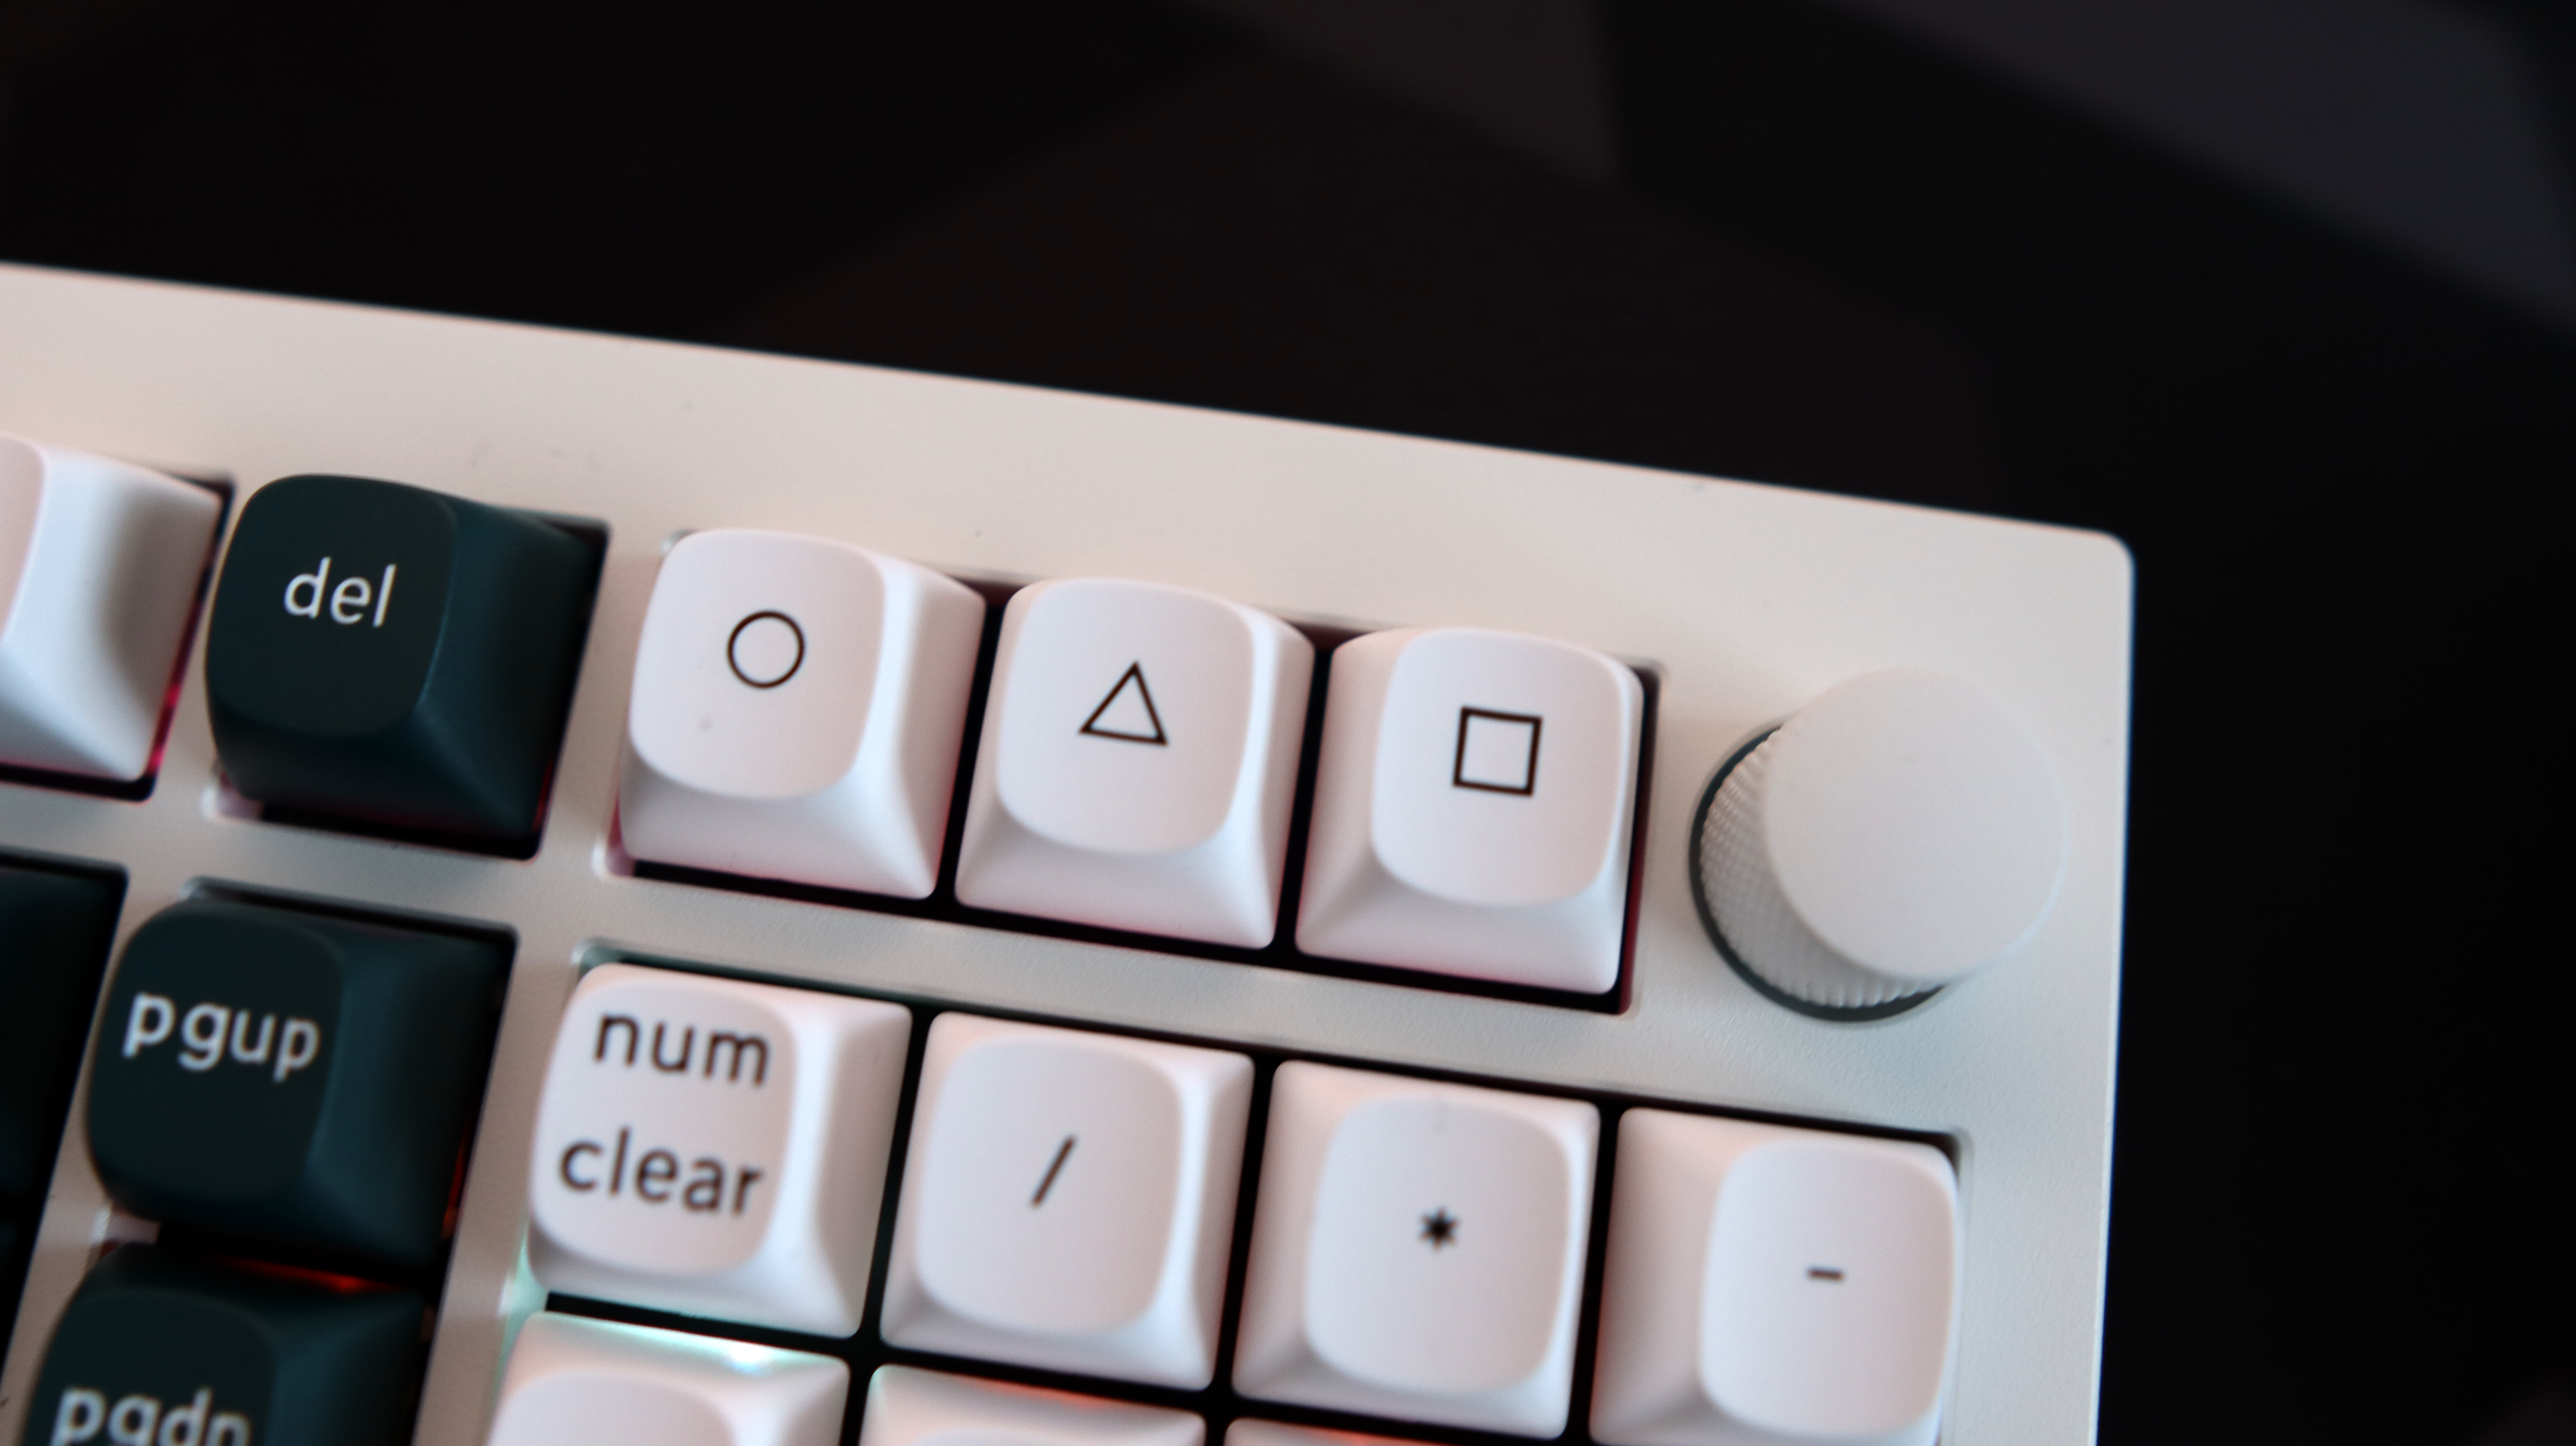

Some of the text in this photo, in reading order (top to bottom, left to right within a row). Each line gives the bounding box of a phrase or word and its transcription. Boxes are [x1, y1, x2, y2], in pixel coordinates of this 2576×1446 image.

[283, 556, 397, 627] del
[122, 992, 319, 1081] pgup
[593, 1013, 771, 1088] num
[558, 1127, 765, 1218] clear
[1030, 1135, 1077, 1208] /
